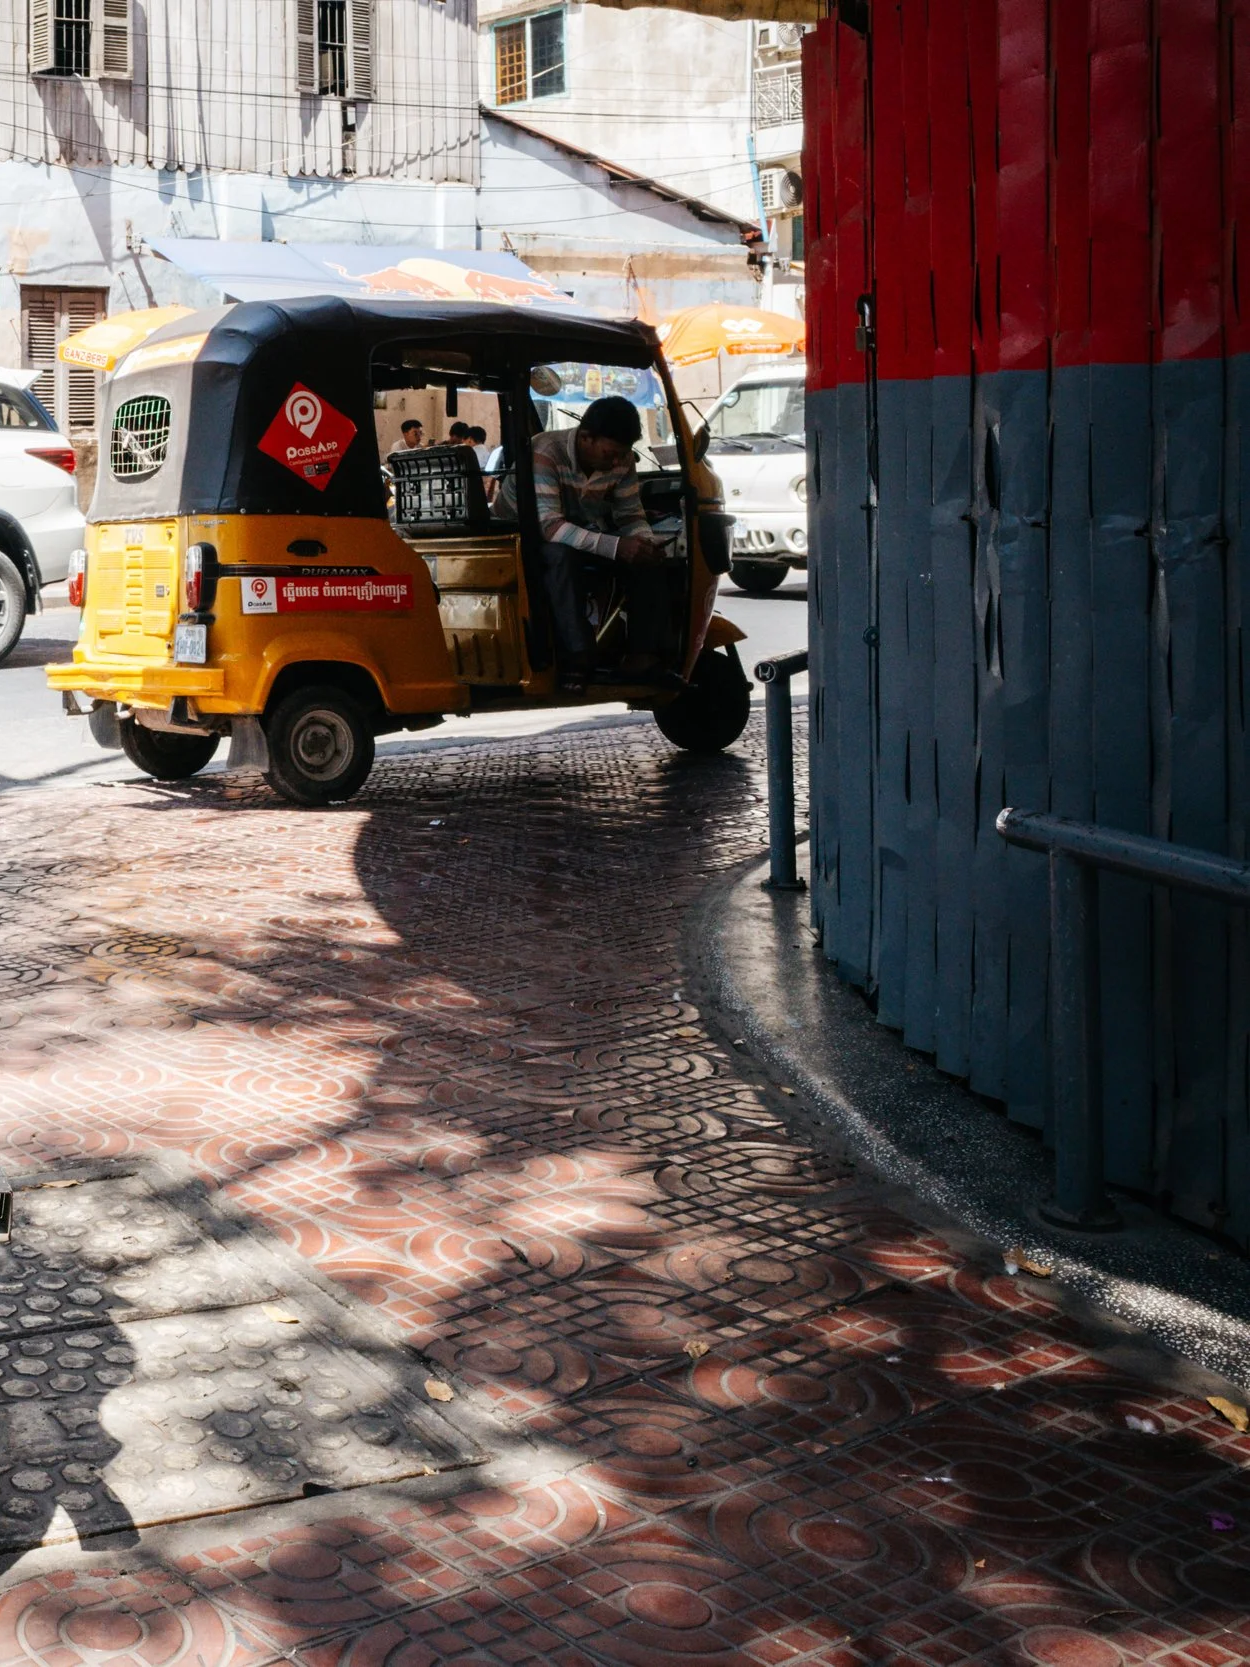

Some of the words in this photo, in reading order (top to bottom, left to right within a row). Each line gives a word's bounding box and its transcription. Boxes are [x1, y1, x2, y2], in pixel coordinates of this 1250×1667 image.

[64, 347, 108, 366] GANZBERG
[125, 528, 144, 544] TVS
[301, 567, 370, 576] DURAMAX
